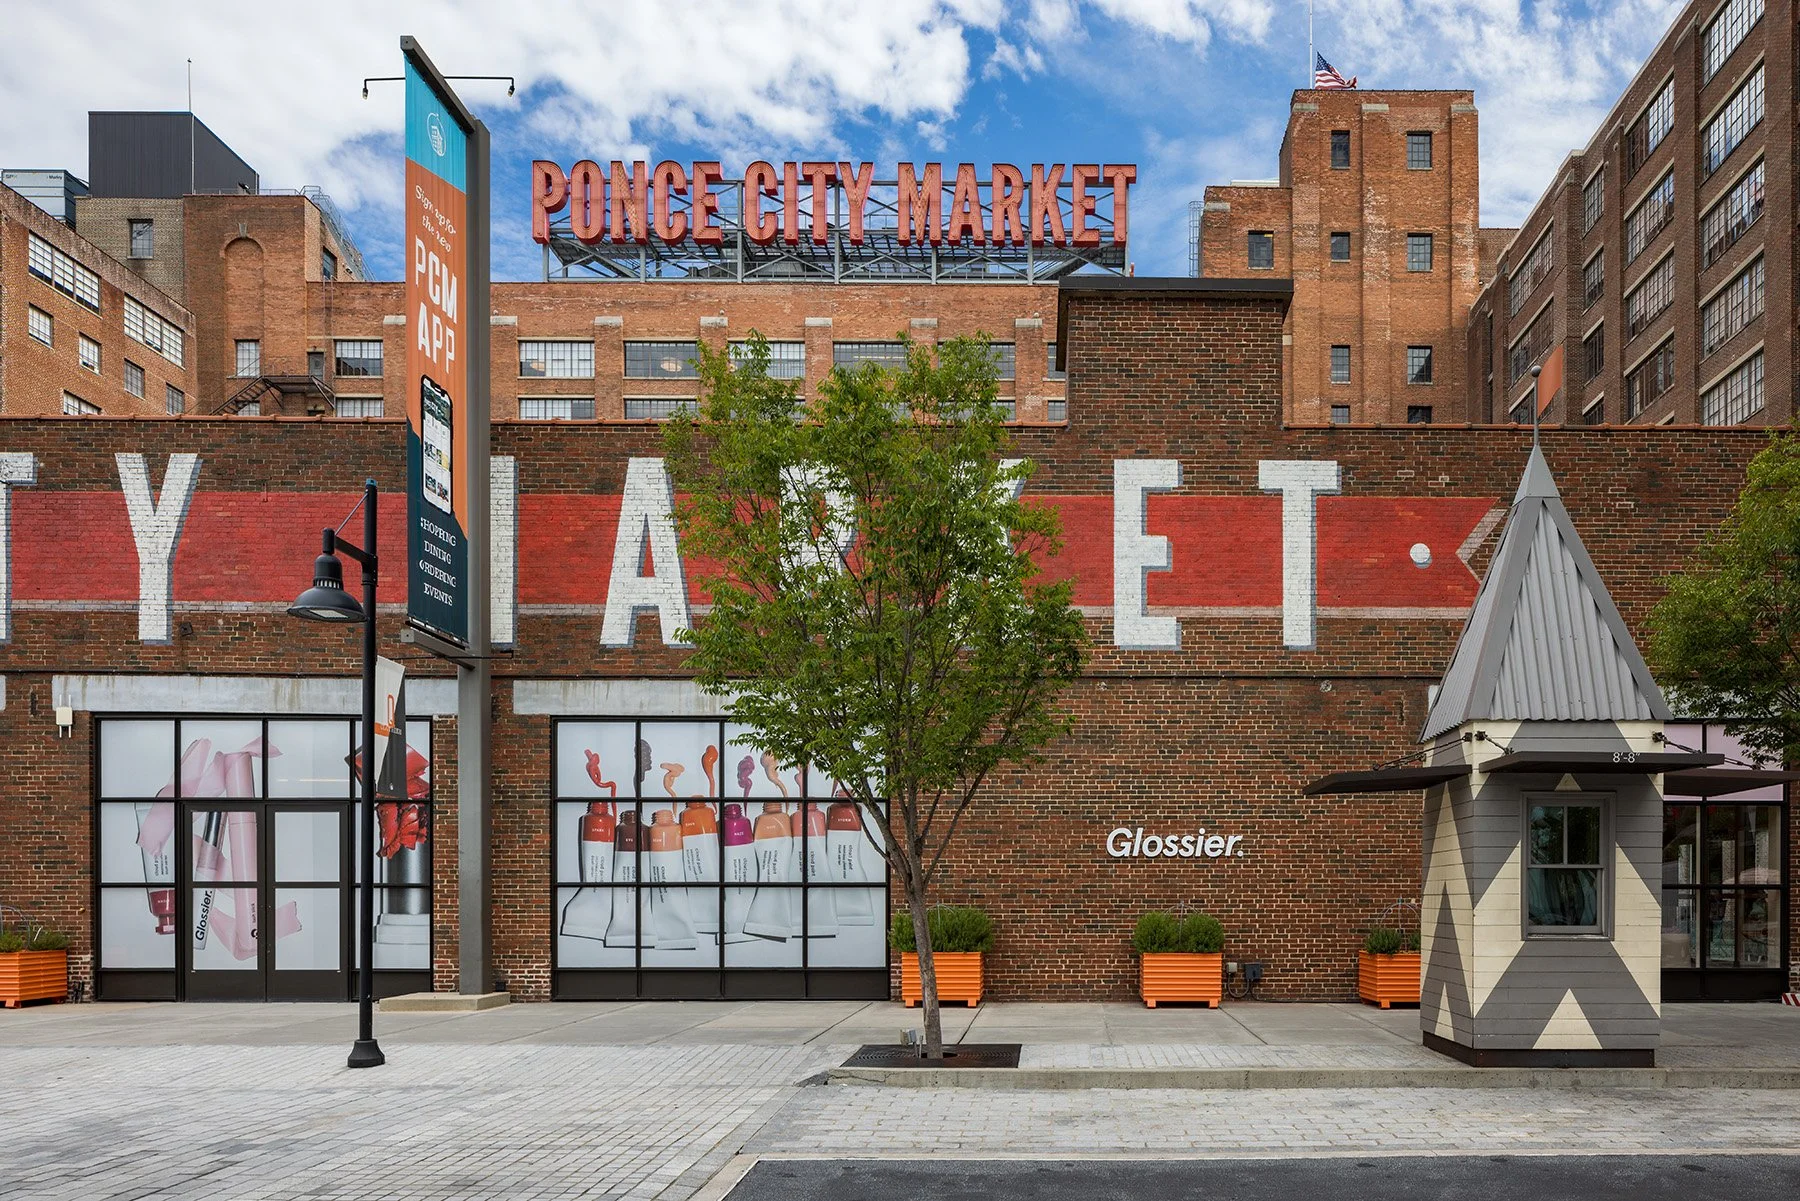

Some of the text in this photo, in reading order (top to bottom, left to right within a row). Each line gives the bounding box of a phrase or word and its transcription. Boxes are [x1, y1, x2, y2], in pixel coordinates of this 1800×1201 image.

[415, 184, 434, 214] Sign
[532, 160, 1137, 248] PONCE CITY MARKET
[422, 215, 435, 236] the
[415, 234, 458, 325] PCM
[417, 301, 455, 375] APP
[423, 540, 452, 565] DINING
[490, 455, 1342, 650] ARET
[419, 559, 457, 588] ORDERING
[423, 582, 453, 606] EVENTS
[1106, 827, 1244, 857] Glossier.
[194, 890, 213, 941] Glossier.
